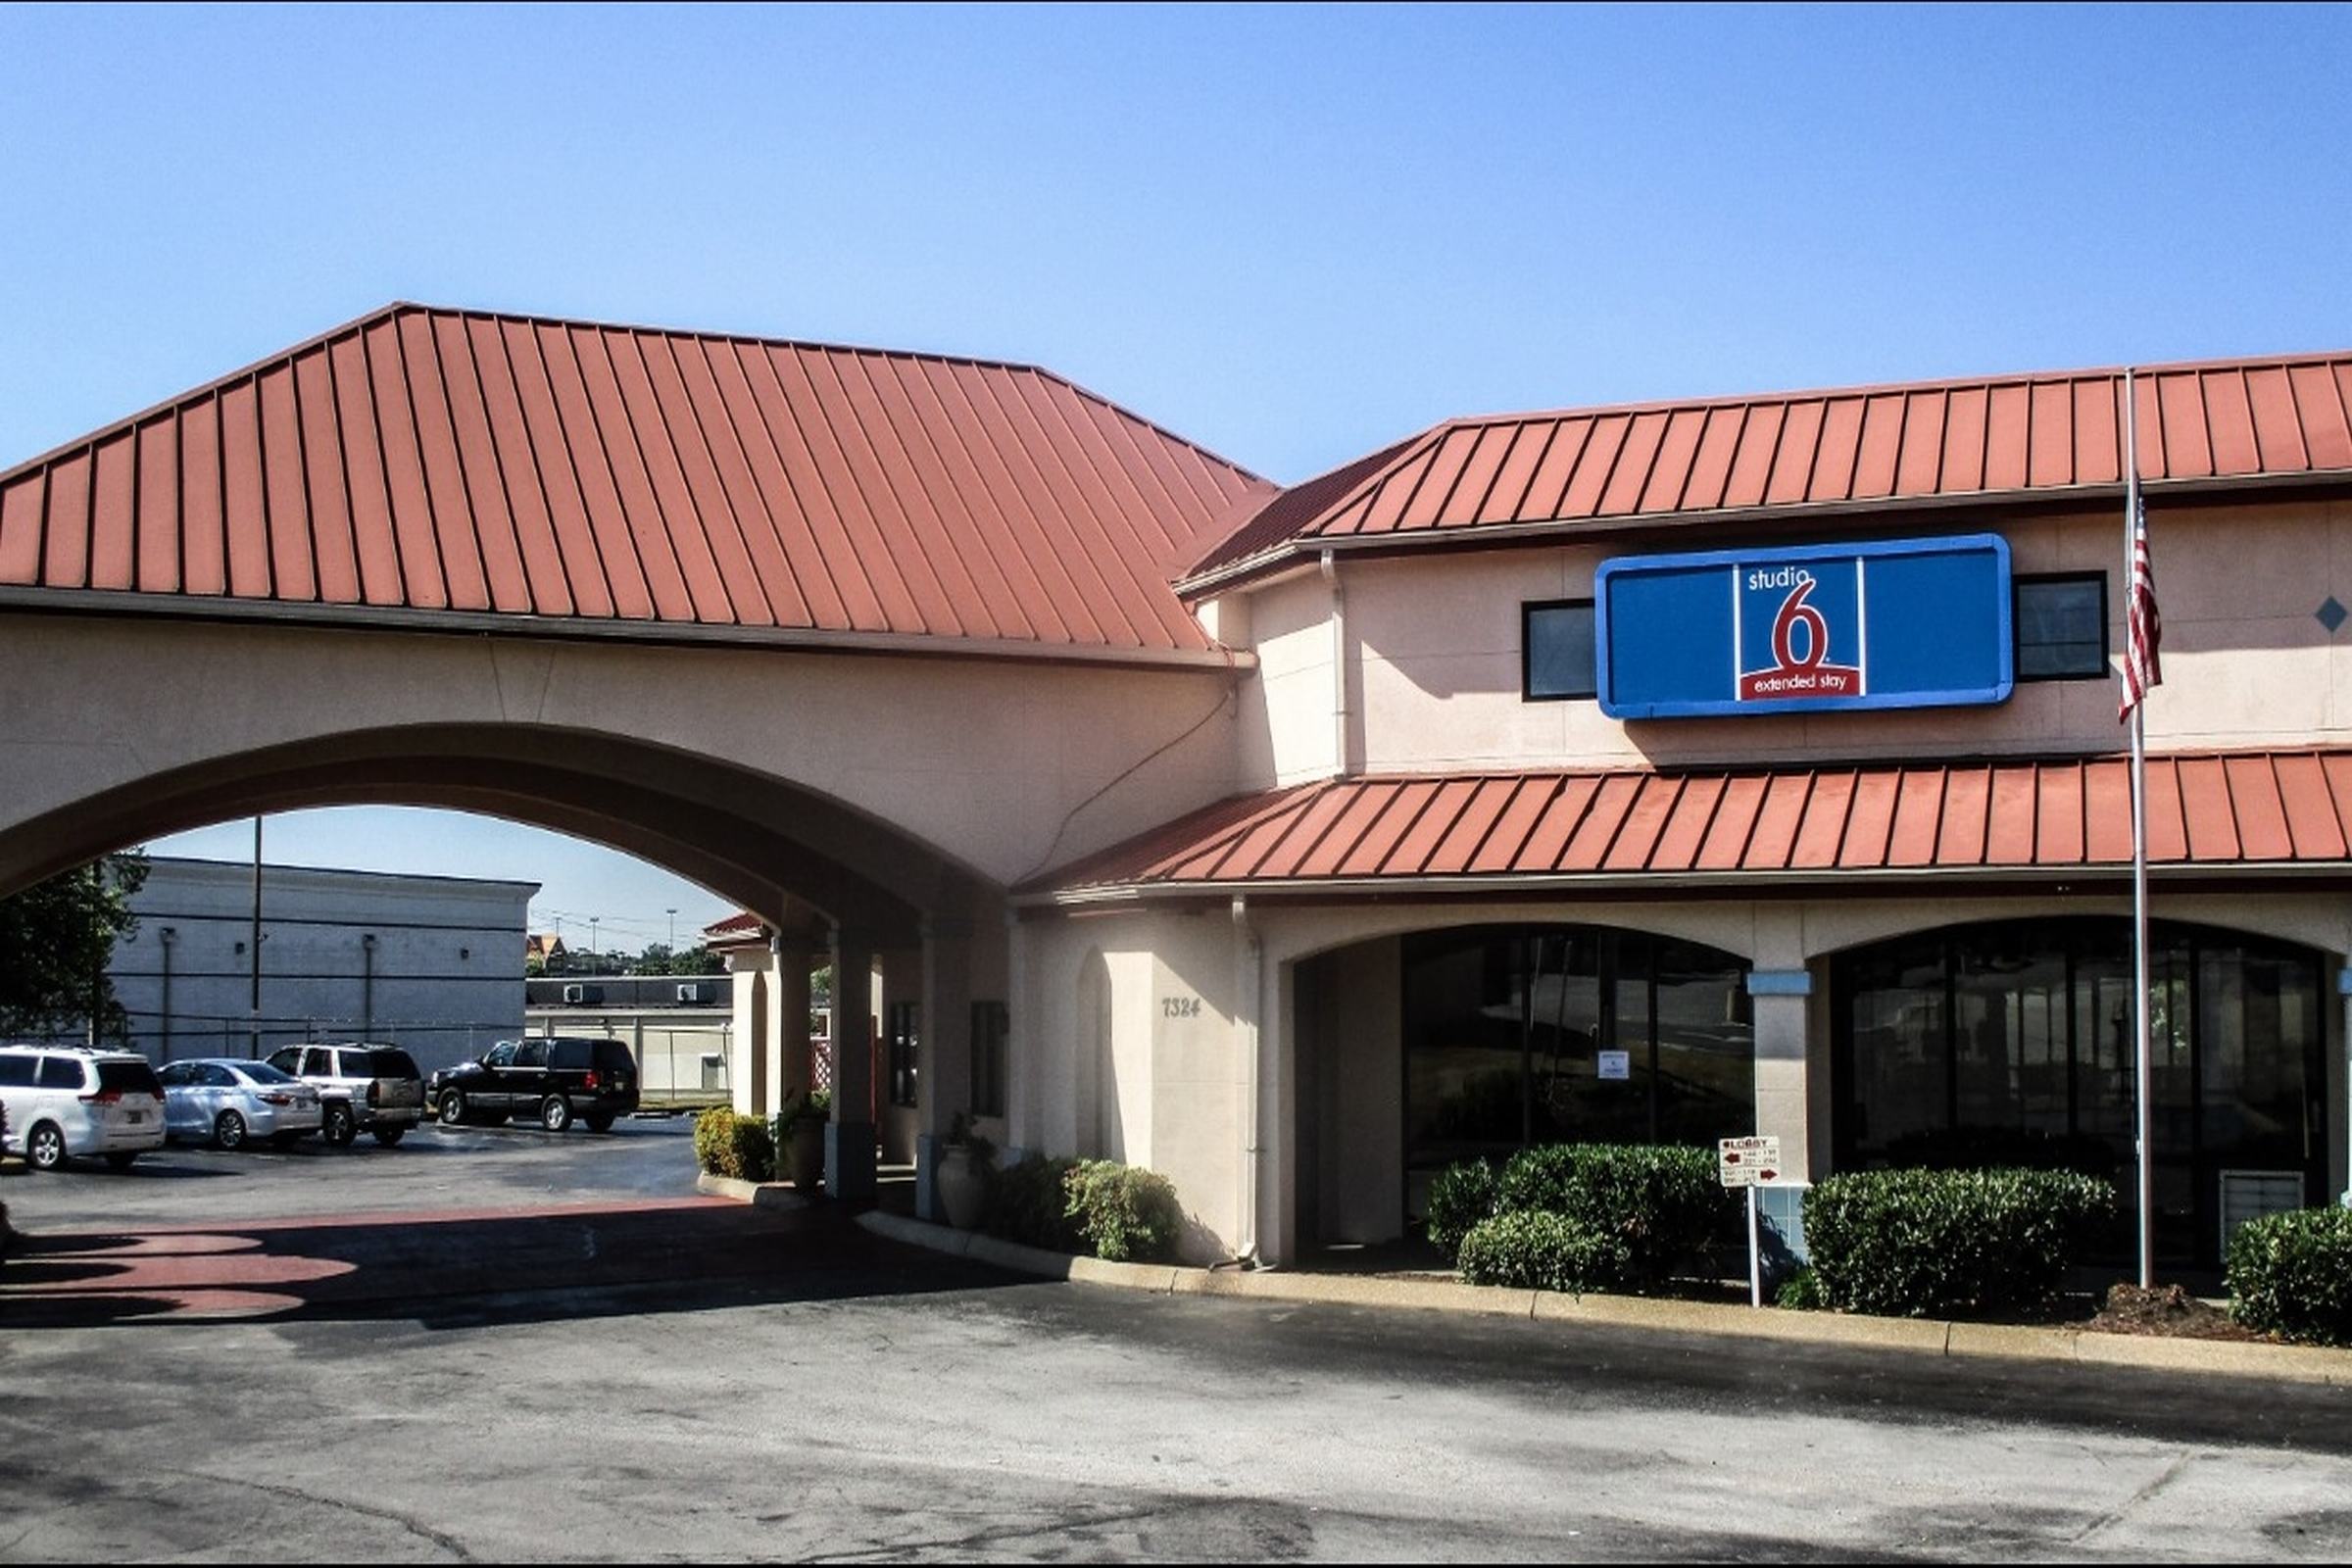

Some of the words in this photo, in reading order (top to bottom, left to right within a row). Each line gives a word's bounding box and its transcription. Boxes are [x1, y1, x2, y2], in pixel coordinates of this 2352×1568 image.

[1748, 566, 1810, 590] studio
[1771, 578, 1829, 668] 6
[1754, 674, 1816, 692] extended
[1820, 675, 1847, 690] stay
[1161, 997, 1200, 1017] 7324
[1731, 1139, 1768, 1150] LOBBY
